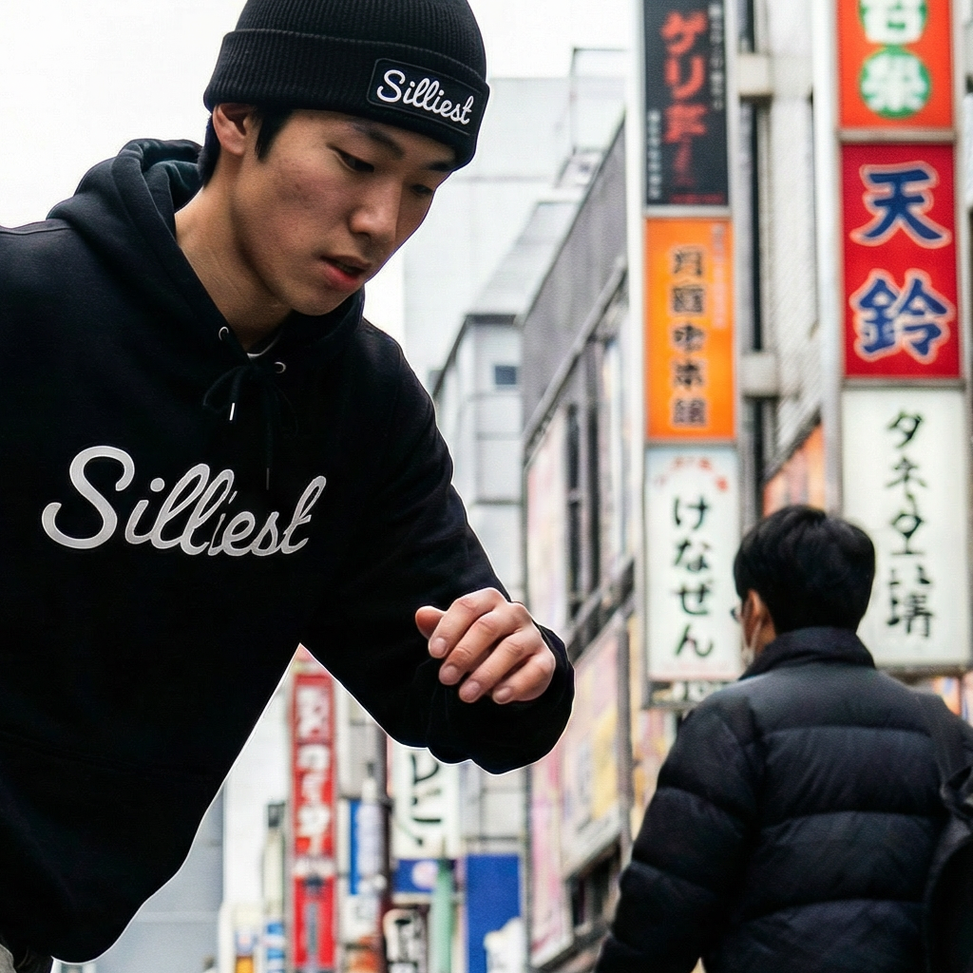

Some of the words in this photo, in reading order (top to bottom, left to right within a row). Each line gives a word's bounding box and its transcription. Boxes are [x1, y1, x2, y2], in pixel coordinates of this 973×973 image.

[376, 69, 474, 125] Silliest
[852, 162, 954, 362] 天鈴
[41, 445, 327, 557] Silliest
